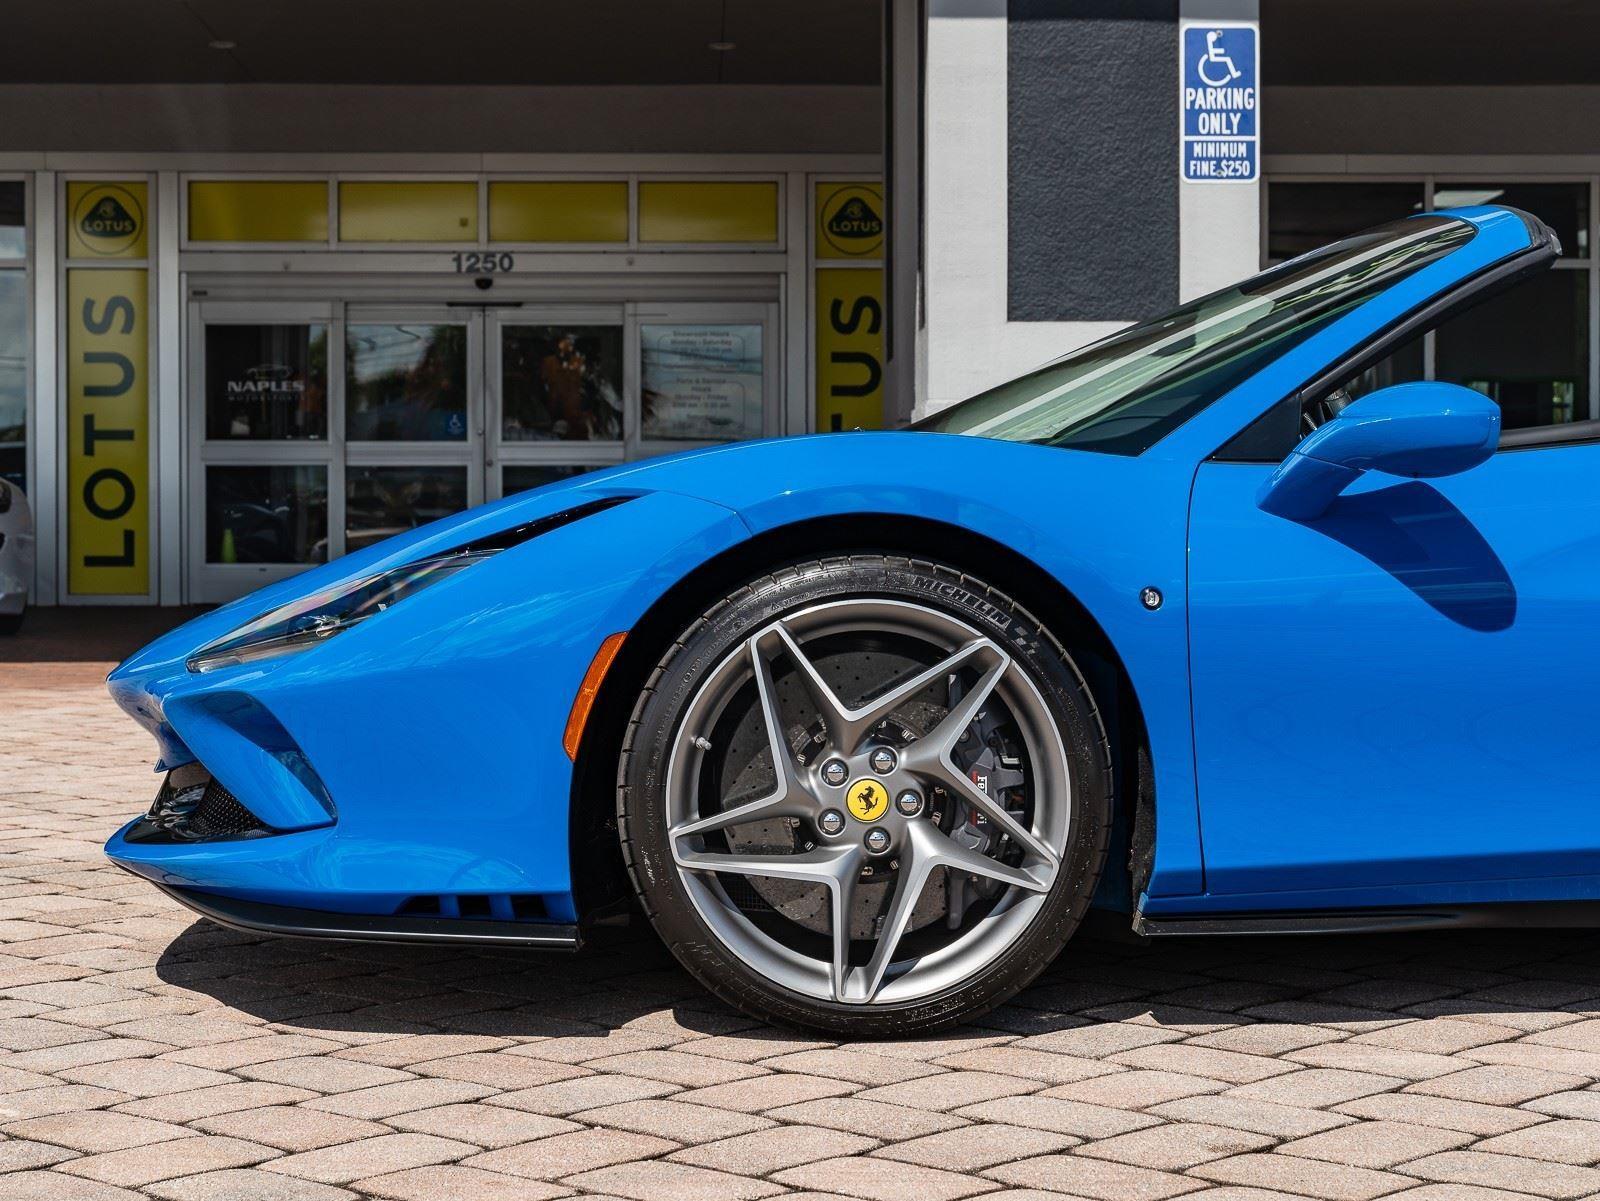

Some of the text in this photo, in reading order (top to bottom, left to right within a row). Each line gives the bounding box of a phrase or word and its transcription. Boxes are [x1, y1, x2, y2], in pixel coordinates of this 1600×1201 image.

[1185, 87, 1255, 110] PARKING
[1198, 112, 1242, 135] ONLY
[1193, 142, 1247, 158] MINIMUM
[1189, 159, 1251, 178] FINE $250
[84, 219, 133, 233] LOTUS
[832, 219, 880, 233] LOTUS
[452, 251, 514, 273] 1250
[226, 380, 306, 393] NAPLES
[83, 295, 135, 568] LOTUS
[913, 574, 1011, 628] MICHELIN
